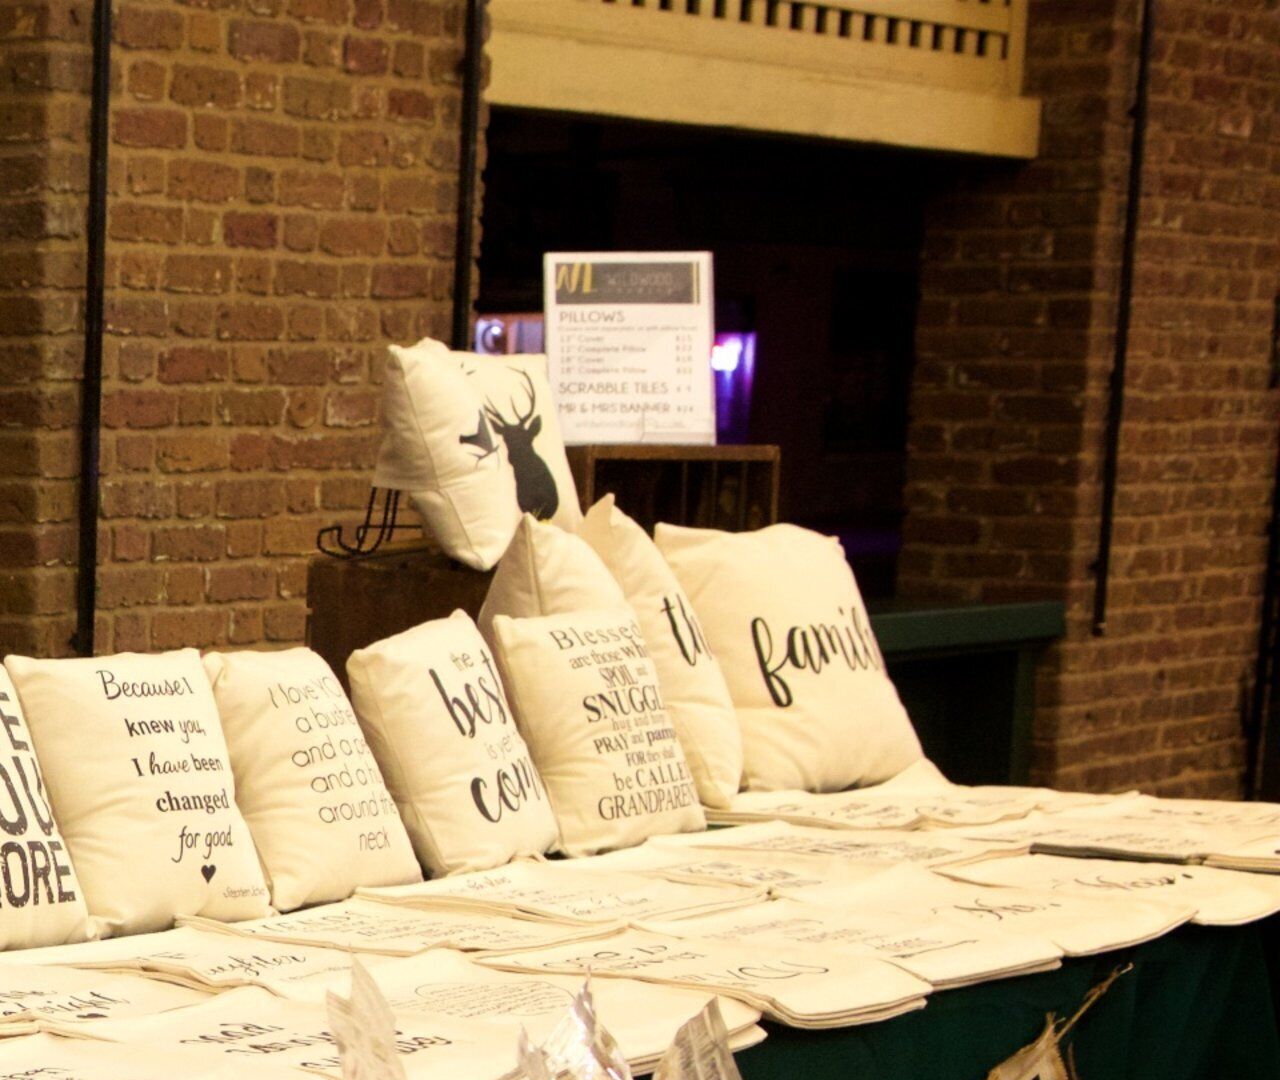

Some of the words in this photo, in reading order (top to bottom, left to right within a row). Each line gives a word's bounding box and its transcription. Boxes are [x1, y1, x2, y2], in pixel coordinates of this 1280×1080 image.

[559, 310, 626, 323] PILLOWS
[558, 381, 630, 395] SCRABBLE
[634, 381, 669, 395] TILES
[450, 651, 475, 673] the
[568, 655, 591, 670] are
[592, 648, 623, 667] those
[95, 669, 186, 700] Because
[598, 664, 639, 689] SPOIL
[280, 682, 320, 706] love
[428, 648, 508, 739] best
[124, 717, 176, 738] knew
[295, 716, 313, 734] a
[291, 735, 338, 768] and
[339, 739, 354, 756] a
[593, 733, 631, 755] PRAY
[131, 757, 144, 777] I
[148, 751, 191, 776] have
[190, 753, 224, 773] been
[624, 751, 646, 768] FOR
[310, 762, 354, 794] and
[356, 772, 368, 789] a
[612, 771, 634, 792] be
[155, 788, 230, 815] changed
[318, 794, 380, 825] around
[171, 825, 201, 864] for
[204, 824, 234, 860] good
[359, 829, 391, 852] neck
